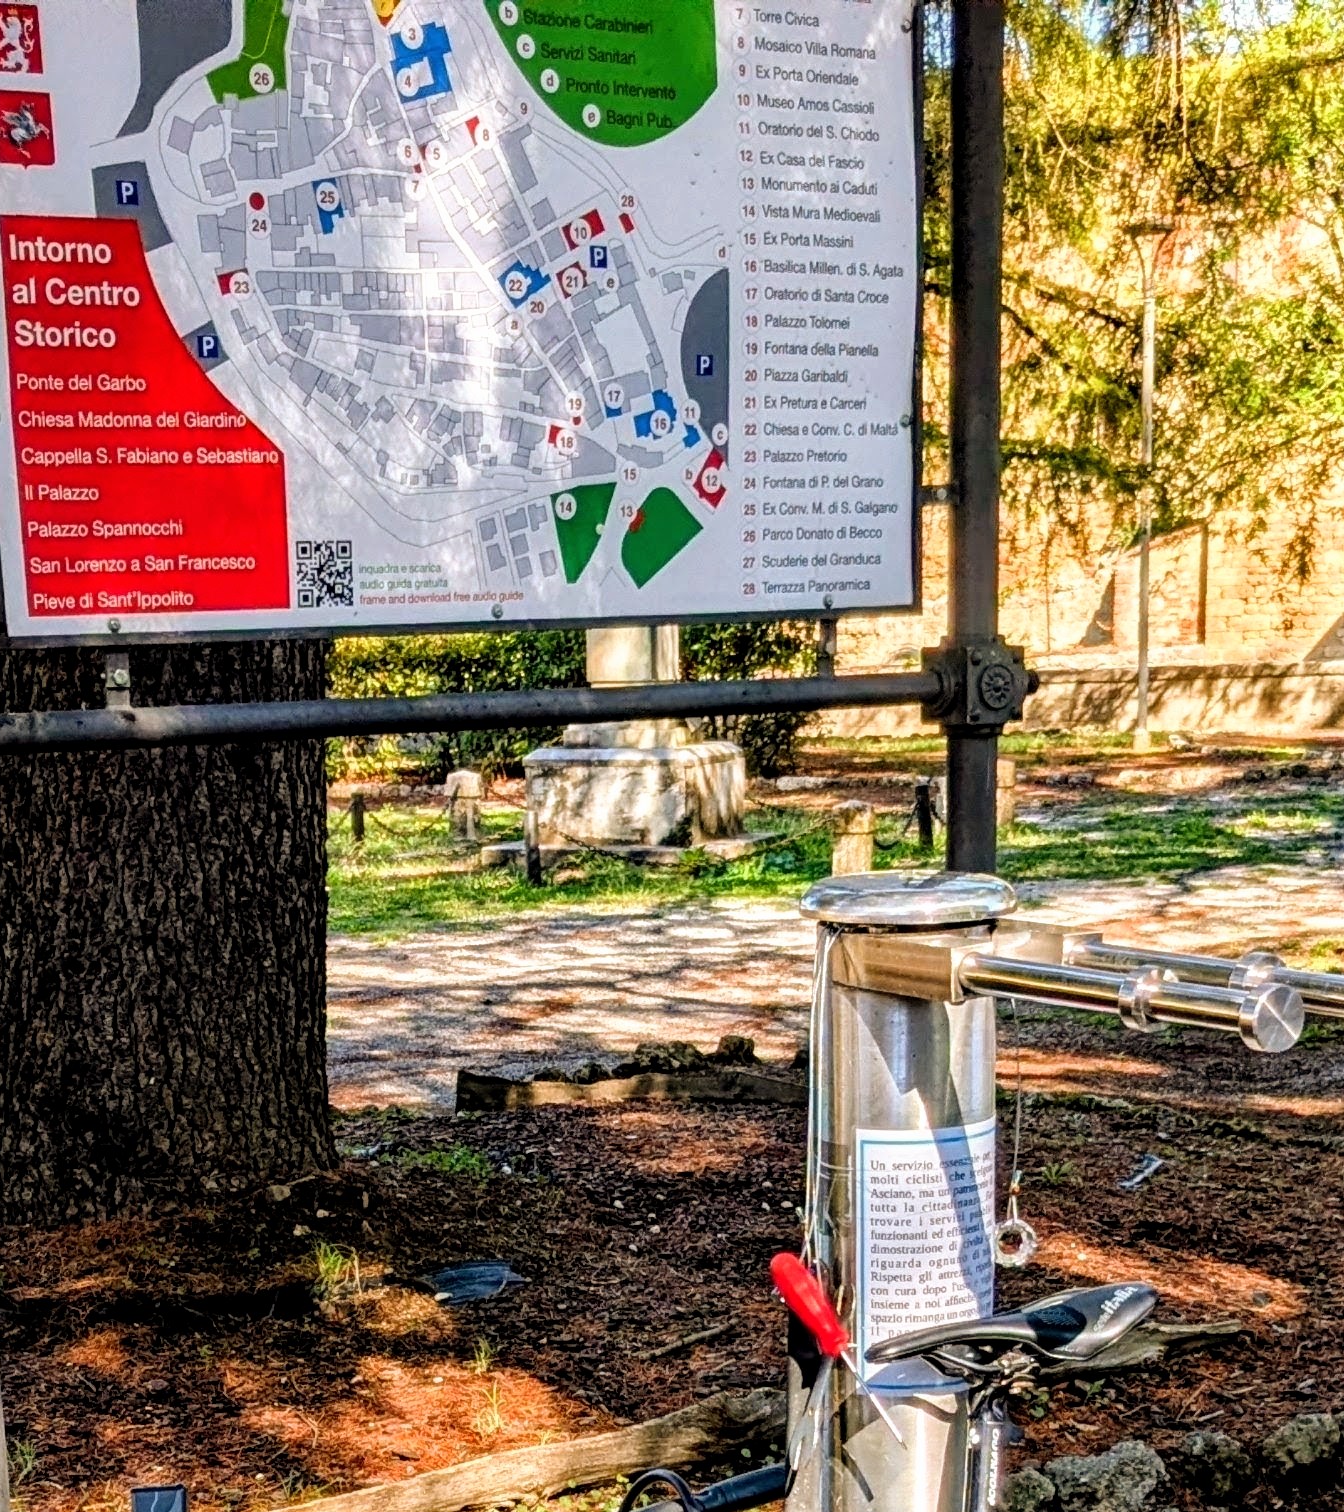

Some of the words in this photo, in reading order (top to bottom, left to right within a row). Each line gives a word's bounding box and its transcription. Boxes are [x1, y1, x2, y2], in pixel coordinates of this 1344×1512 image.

[504, 9, 513, 19] b
[524, 9, 579, 28] Stazione
[584, 14, 653, 34] Carabinieri
[736, 8, 743, 20] 7
[754, 8, 782, 23] Torre
[785, 11, 819, 27] Civica
[522, 43, 530, 52] c
[541, 45, 583, 61] Servizi
[588, 48, 636, 64] Sanitari
[738, 37, 744, 48] 8
[754, 39, 802, 54] Mosaico
[805, 41, 828, 56] Villa
[831, 44, 876, 60] Romana
[254, 73, 269, 85] 26
[739, 65, 746, 76] 9
[756, 65, 770, 80] Ex
[774, 67, 803, 82] Porta
[547, 75, 554, 87] d
[566, 78, 609, 94] Pronto
[738, 93, 750, 106] 10
[757, 95, 794, 110] Museo
[798, 97, 829, 112] Amos
[832, 99, 874, 114] Cassioli
[588, 112, 595, 121] e
[606, 111, 643, 129] Bagni
[740, 149, 753, 162] 12
[760, 151, 774, 164] Ex
[778, 152, 806, 166] Casa
[809, 153, 825, 167] del
[828, 155, 864, 169] Fascio
[122, 183, 134, 203] P
[743, 205, 755, 217] 14
[762, 203, 789, 218] Vista
[793, 205, 820, 220] Mura
[824, 207, 880, 222] Medioevali
[744, 233, 756, 245] 15
[764, 231, 778, 245] Ex
[781, 231, 810, 246] Porta
[813, 233, 853, 248] Massini
[10, 233, 111, 264] Intorno
[13, 278, 35, 305] al
[46, 279, 140, 305] Centro
[746, 288, 757, 300] 17
[764, 285, 808, 302] Oratorio
[812, 287, 821, 301] di
[824, 289, 854, 302] Santa
[858, 289, 889, 304] Croce
[746, 315, 758, 327] 18
[765, 314, 806, 328] Palazzo
[809, 315, 850, 329] Tolomei
[15, 319, 116, 348] Storico
[202, 335, 215, 356] P
[17, 374, 62, 391] Ponte
[68, 374, 92, 391] del
[97, 374, 146, 391] Garbo
[745, 369, 757, 382] 20
[764, 369, 798, 382] Piazza
[802, 369, 848, 383] Garibaldi
[18, 410, 73, 428] Chiesa
[78, 411, 151, 428] Madonna
[156, 411, 179, 428] del
[184, 412, 246, 428] Giardino
[21, 448, 92, 467] Cappella
[97, 448, 113, 464] S.
[117, 448, 178, 464] Fabiano
[183, 451, 192, 463] e
[196, 448, 279, 464] Sebastiano
[744, 450, 757, 462] 23
[764, 449, 804, 463] Palazzo
[807, 449, 847, 462] Pretorio
[25, 485, 33, 500] Il
[38, 484, 99, 501] Palazzo
[28, 521, 88, 538] Palazzo
[92, 519, 183, 538] Spannocchi
[744, 530, 756, 542] 26
[763, 527, 793, 542] Parco
[796, 527, 834, 540] Donato
[837, 526, 846, 539] di
[850, 525, 882, 538] Becco
[30, 556, 61, 573] San
[65, 555, 126, 572] Lorenzo
[131, 558, 140, 571] a
[145, 554, 173, 572] San
[178, 554, 255, 571] Francesco
[359, 563, 399, 574] inquadra
[402, 565, 407, 573] e
[410, 563, 441, 573] scarica
[743, 557, 755, 569] 27
[762, 554, 808, 568] Scuderie
[811, 553, 827, 567] del
[830, 553, 881, 566] Granduca
[360, 579, 383, 588] audio
[388, 578, 412, 590] guida
[414, 578, 448, 589] gratuita
[743, 584, 755, 596] 28
[763, 581, 805, 594] Terrazza
[809, 579, 870, 593] Panoramica
[33, 593, 74, 609] Pieve
[79, 593, 93, 609] di
[97, 591, 194, 609] Sant'Ippolito
[360, 594, 386, 604] frame
[388, 593, 405, 603] and
[408, 592, 451, 603] download
[453, 592, 471, 602] free
[473, 591, 495, 602] audio
[498, 591, 524, 603] guide
[871, 1161, 885, 1170] Un
[892, 1161, 933, 1170] servizio
[871, 1175, 898, 1184] molti
[906, 1175, 943, 1184] ciclisti
[949, 1172, 965, 1181] che
[871, 1189, 915, 1199] Asciano,
[919, 1190, 934, 1198] ma
[871, 1204, 896, 1212] tutta
[904, 1203, 914, 1212] la
[871, 1218, 911, 1226] trovare
[871, 1231, 927, 1240] funzionanti
[932, 1230, 943, 1238] ed
[871, 1244, 943, 1253] dimostrazione
[949, 1242, 957, 1250] di
[871, 1272, 912, 1282] Rispetta
[919, 1271, 932, 1283] gli
[895, 1287, 916, 1295] cura
[923, 1284, 946, 1295] dopo
[871, 1314, 902, 1324] spazio
[905, 1311, 944, 1323] rimanga
